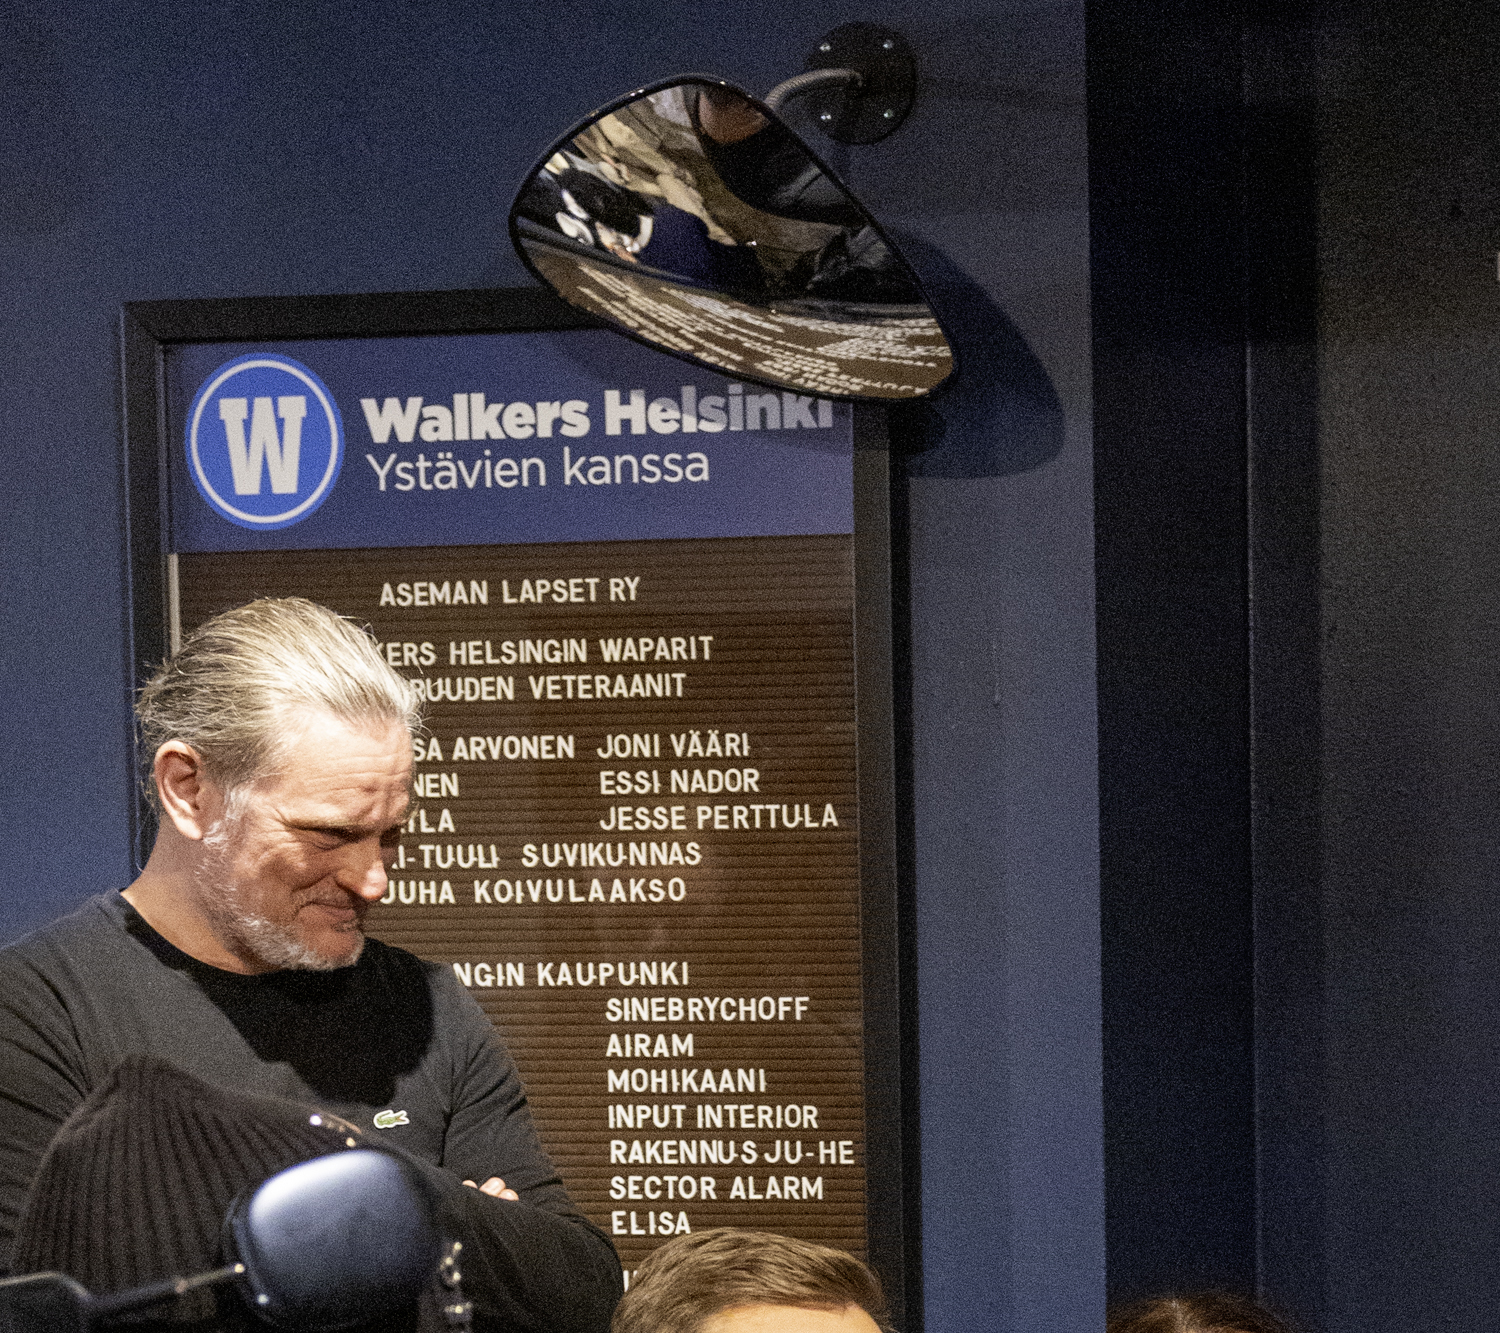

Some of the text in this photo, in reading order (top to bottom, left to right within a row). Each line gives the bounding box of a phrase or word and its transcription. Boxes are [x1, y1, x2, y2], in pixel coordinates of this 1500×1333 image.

[360, 383, 836, 444] Walkers Helsinki
[218, 396, 308, 496] W
[366, 446, 711, 493] Ystävien kanssa
[380, 577, 640, 606] ASEMAN LAPSET RY
[451, 639, 587, 666] HELSINGIN
[600, 636, 713, 662] WAPARIT
[529, 673, 687, 699] VETERAANIT
[452, 735, 575, 761] ARVONEN
[597, 729, 750, 759] JONI VÄÄRI
[600, 767, 760, 795] ESSI NADOR
[600, 803, 839, 831] JESSE PERTTULA
[522, 843, 701, 868] SUVIKUNNAS
[380, 877, 687, 905] JUHA KOIVULAAKSO
[453, 961, 689, 987] NGIN KAUPUNKI
[605, 996, 810, 1022] SINEBRYCHOFF
[606, 1033, 695, 1058] AIRAM
[607, 1068, 767, 1093] MOHIKAANI
[608, 1104, 819, 1129] INPUT INTERIOR
[610, 1140, 856, 1165] RAKENNUS JU-HE
[609, 1175, 824, 1201] SECTOR ALARM
[611, 1210, 692, 1236] ELISA
